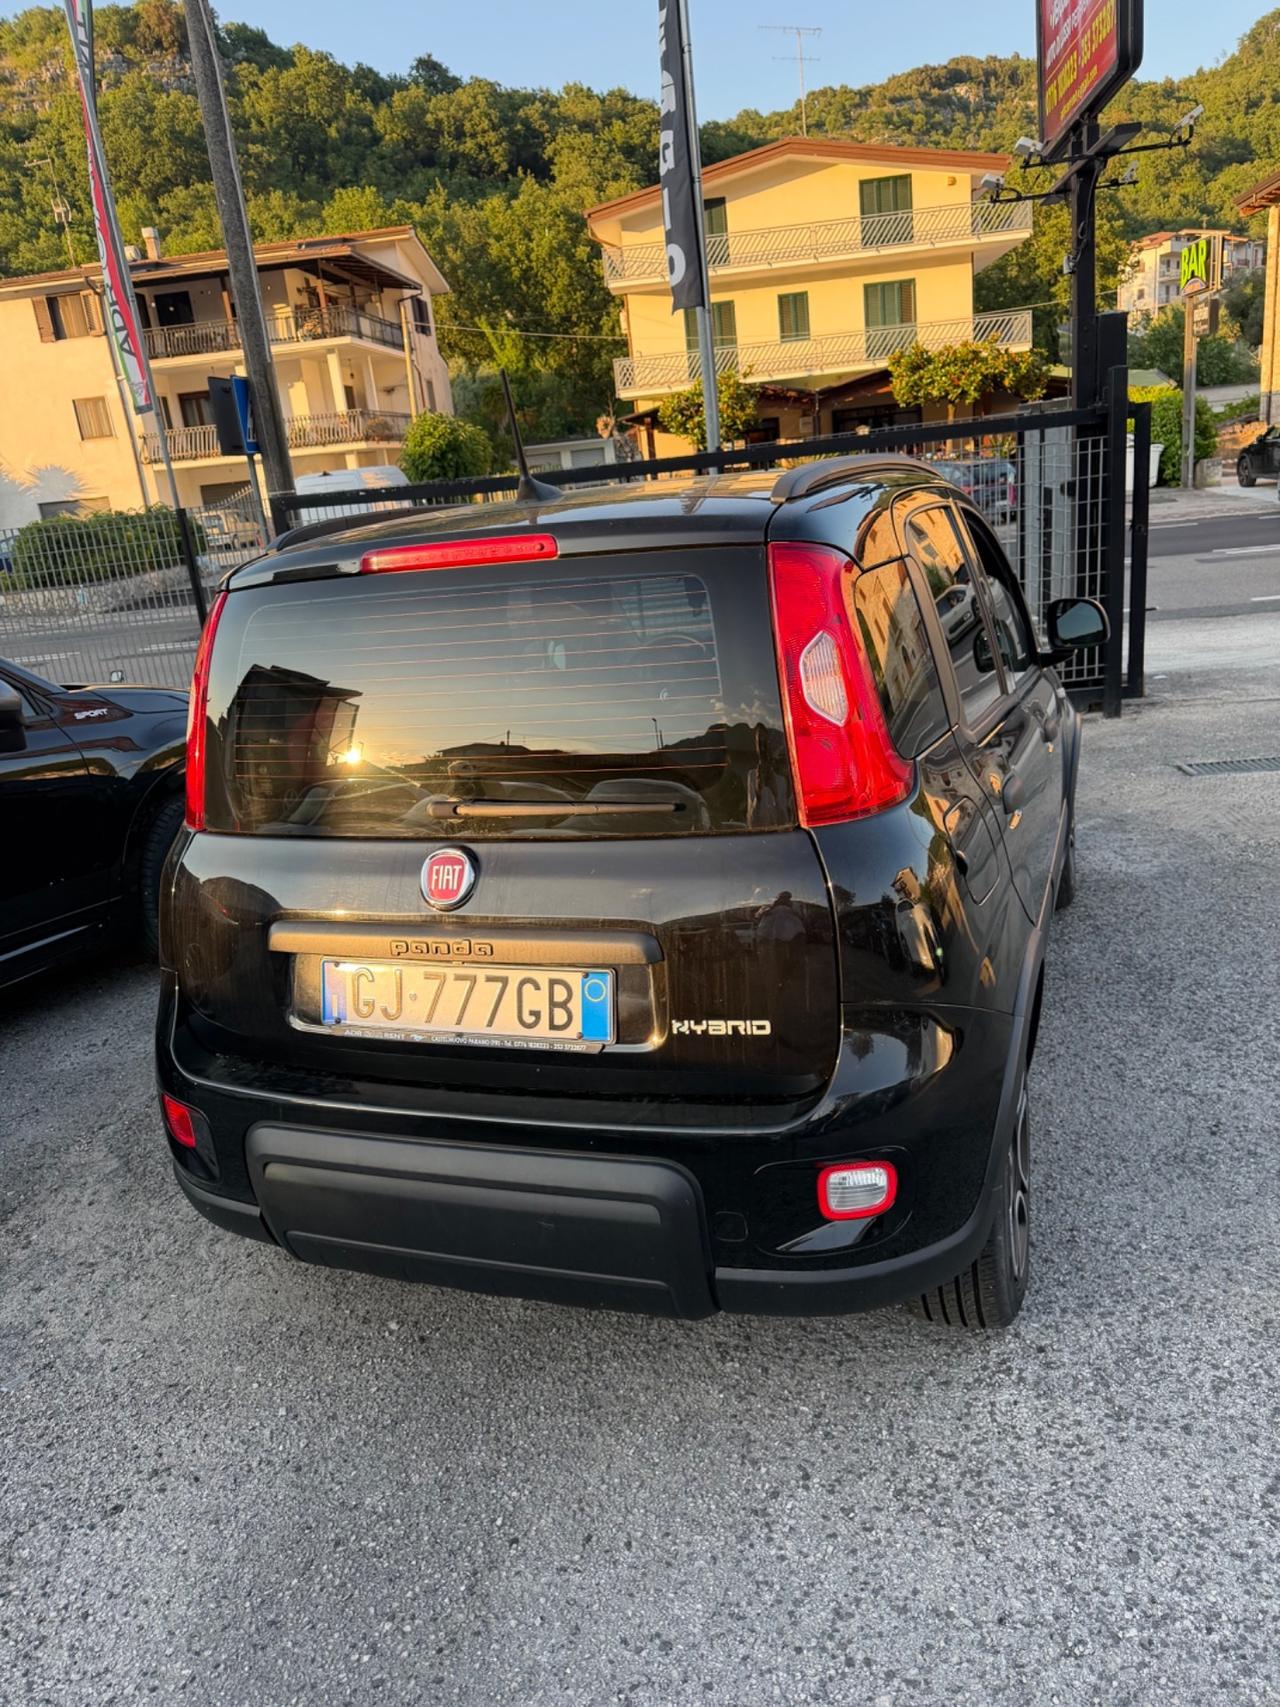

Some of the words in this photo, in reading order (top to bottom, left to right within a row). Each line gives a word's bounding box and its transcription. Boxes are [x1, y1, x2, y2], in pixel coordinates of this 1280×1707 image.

[1181, 239, 1207, 289] BAR
[74, 707, 108, 720] SPORT
[431, 865, 463, 890] FIAT
[390, 939, 494, 957] panda
[671, 1018, 772, 1036] HYBRID
